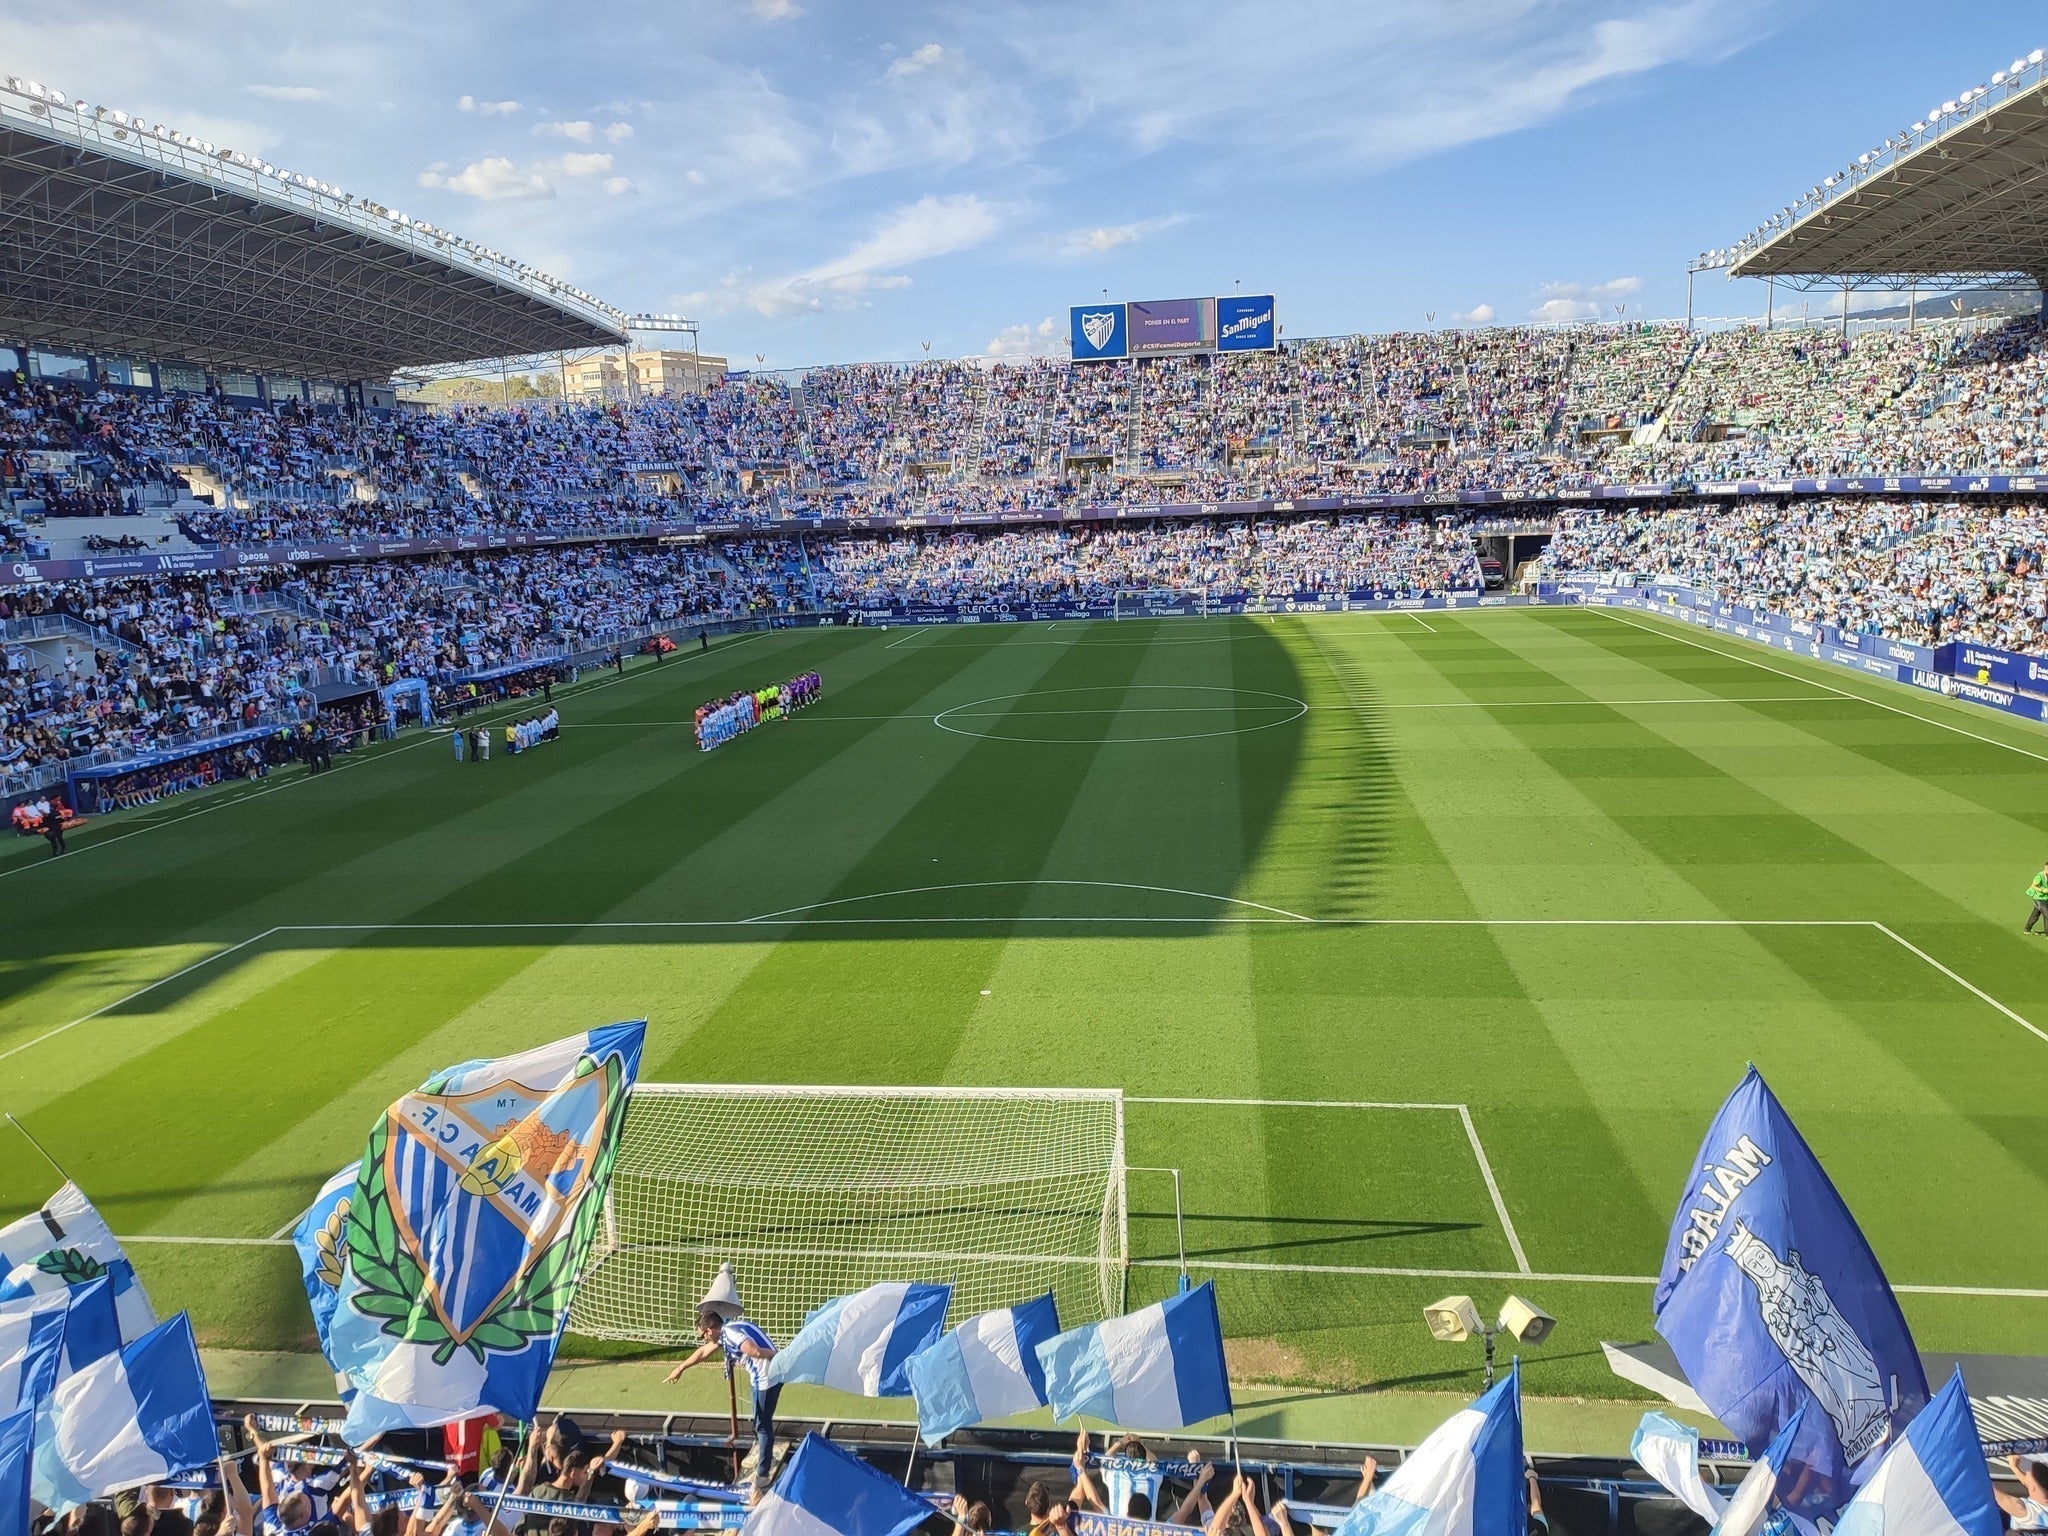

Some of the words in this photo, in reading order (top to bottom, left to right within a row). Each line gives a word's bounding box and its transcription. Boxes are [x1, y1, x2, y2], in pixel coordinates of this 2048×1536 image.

[631, 462, 675, 470] BENAMIEL
[1884, 478, 1900, 488] SUR
[1442, 588, 1478, 598] hummel
[1298, 603, 1326, 612] vithas
[860, 608, 892, 618] hummel
[1888, 643, 1915, 663] málaga
[1912, 669, 1940, 690] LALIGA
[1950, 680, 2006, 705] HYPERMOTION
[532, 1504, 548, 1512] DE
